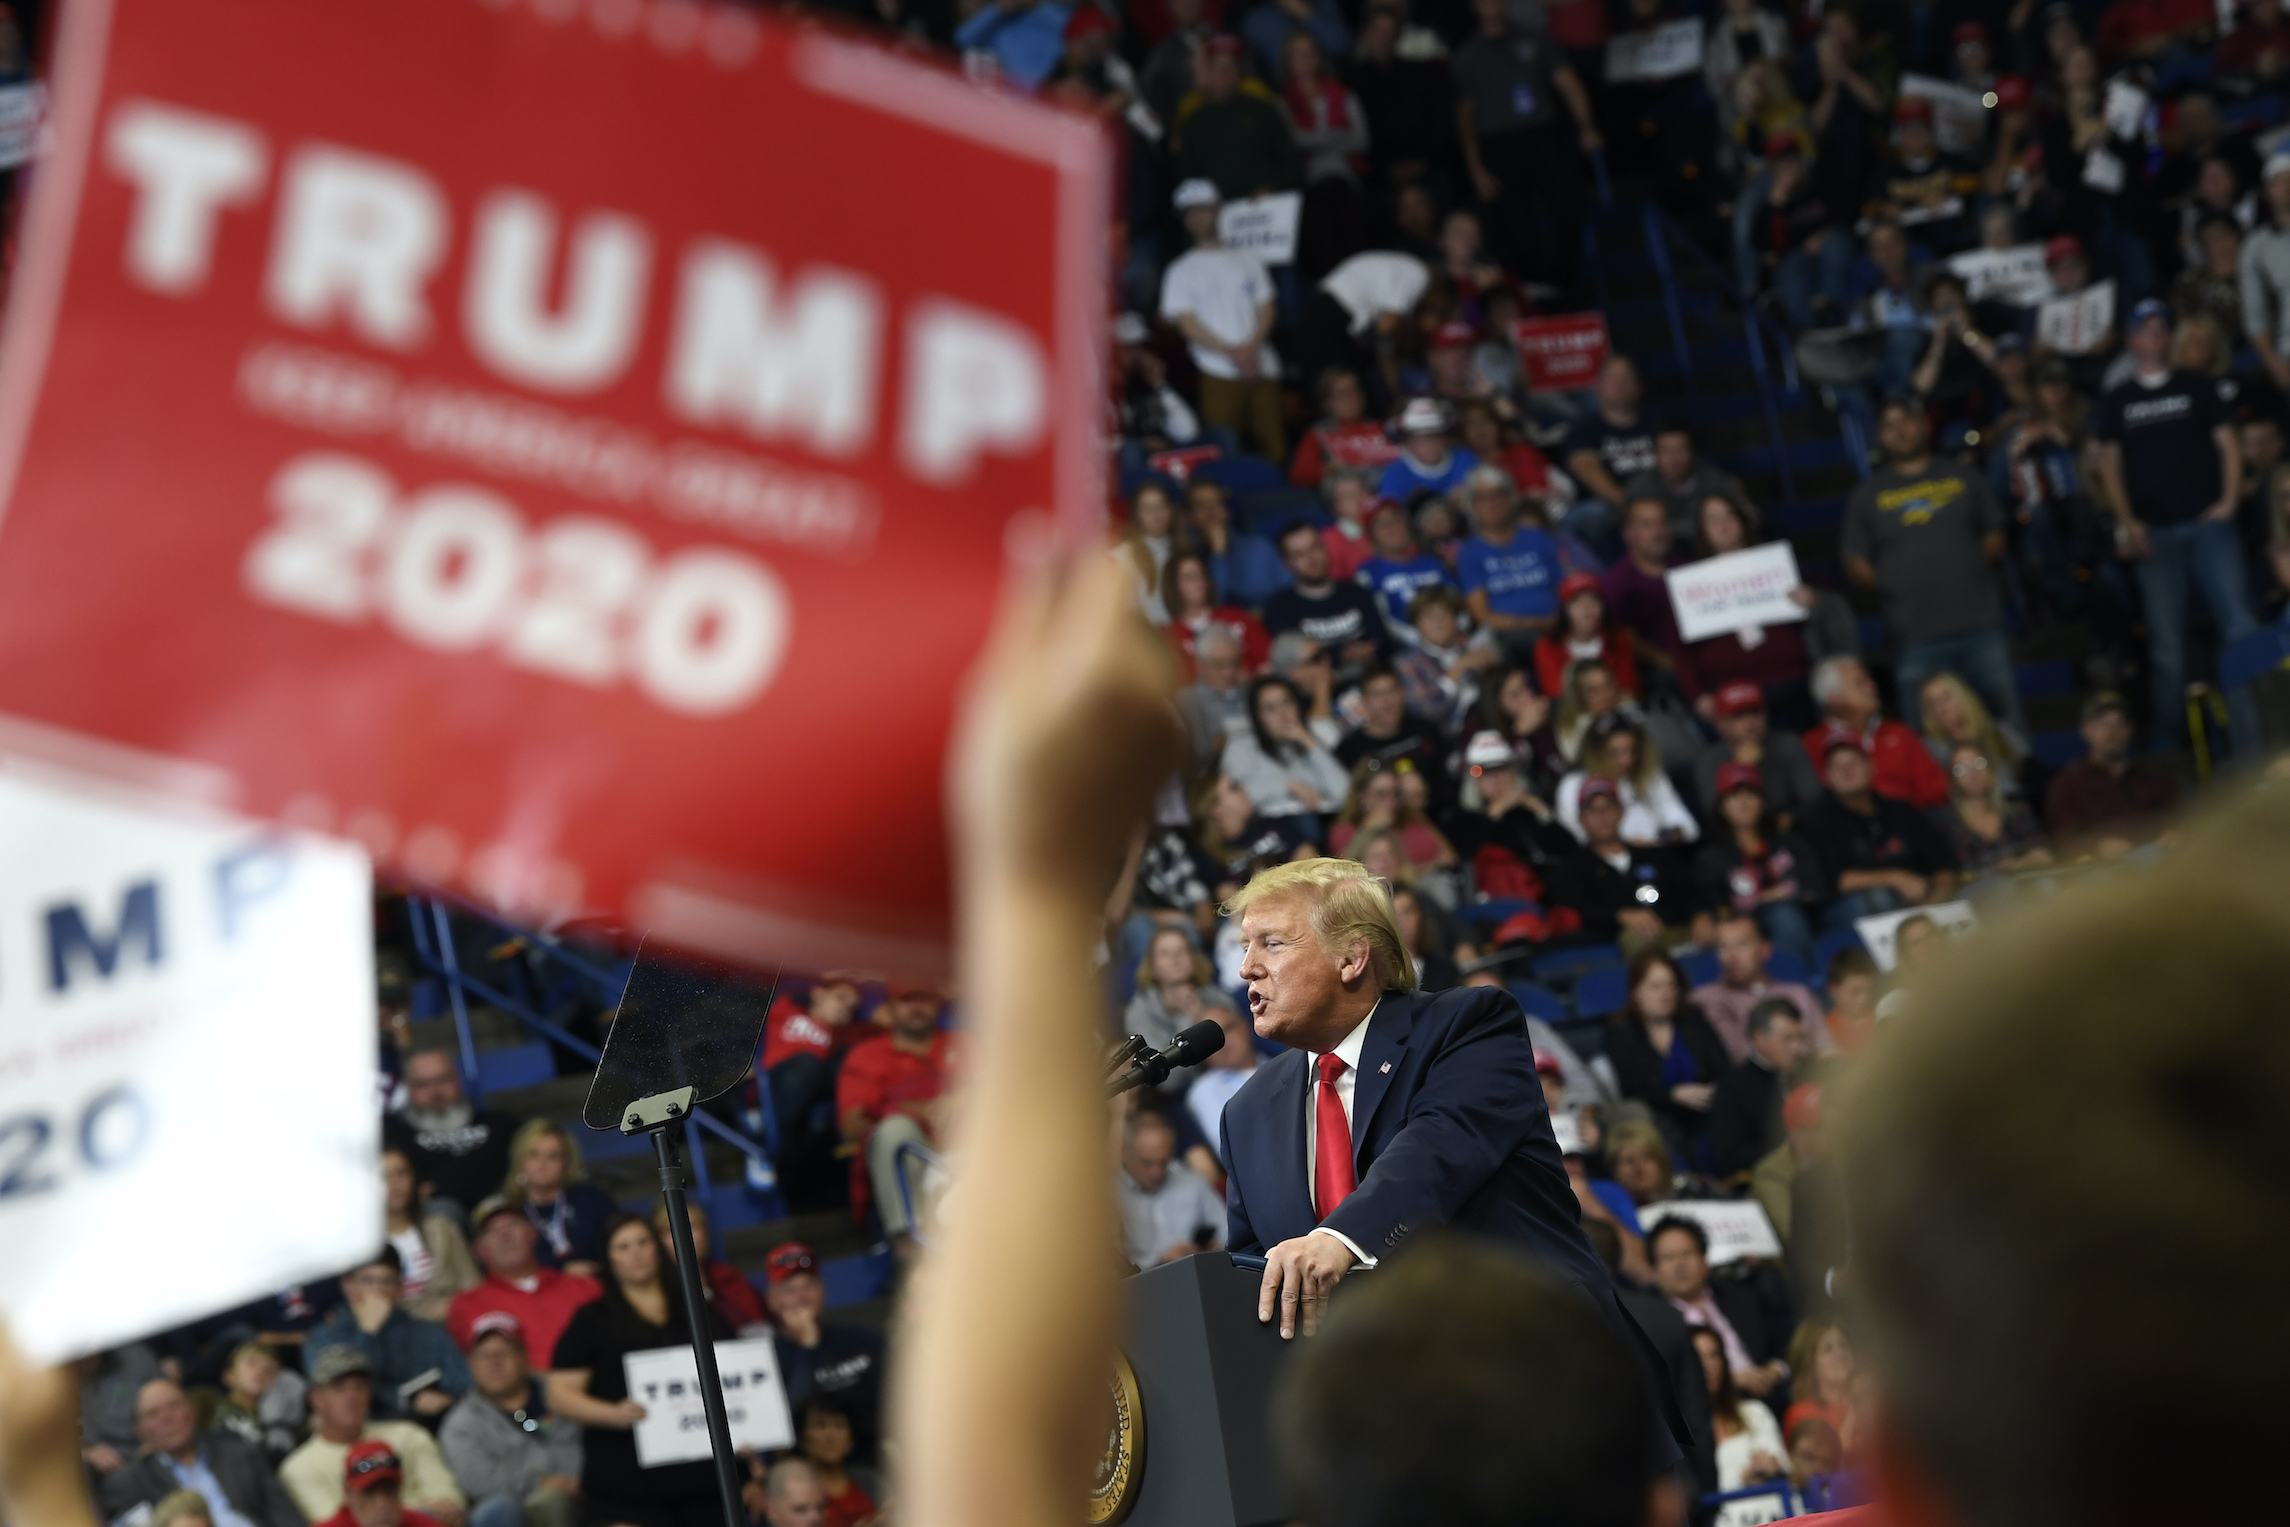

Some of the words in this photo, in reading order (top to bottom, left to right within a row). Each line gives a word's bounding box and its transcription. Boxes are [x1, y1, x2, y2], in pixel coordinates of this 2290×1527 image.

[105, 98, 1051, 486] TRUMP
[240, 450, 792, 716] 2020
[0, 842, 293, 996] MP
[680, 1408, 747, 1431] 200
[1106, 1451, 1130, 1512] STATES
